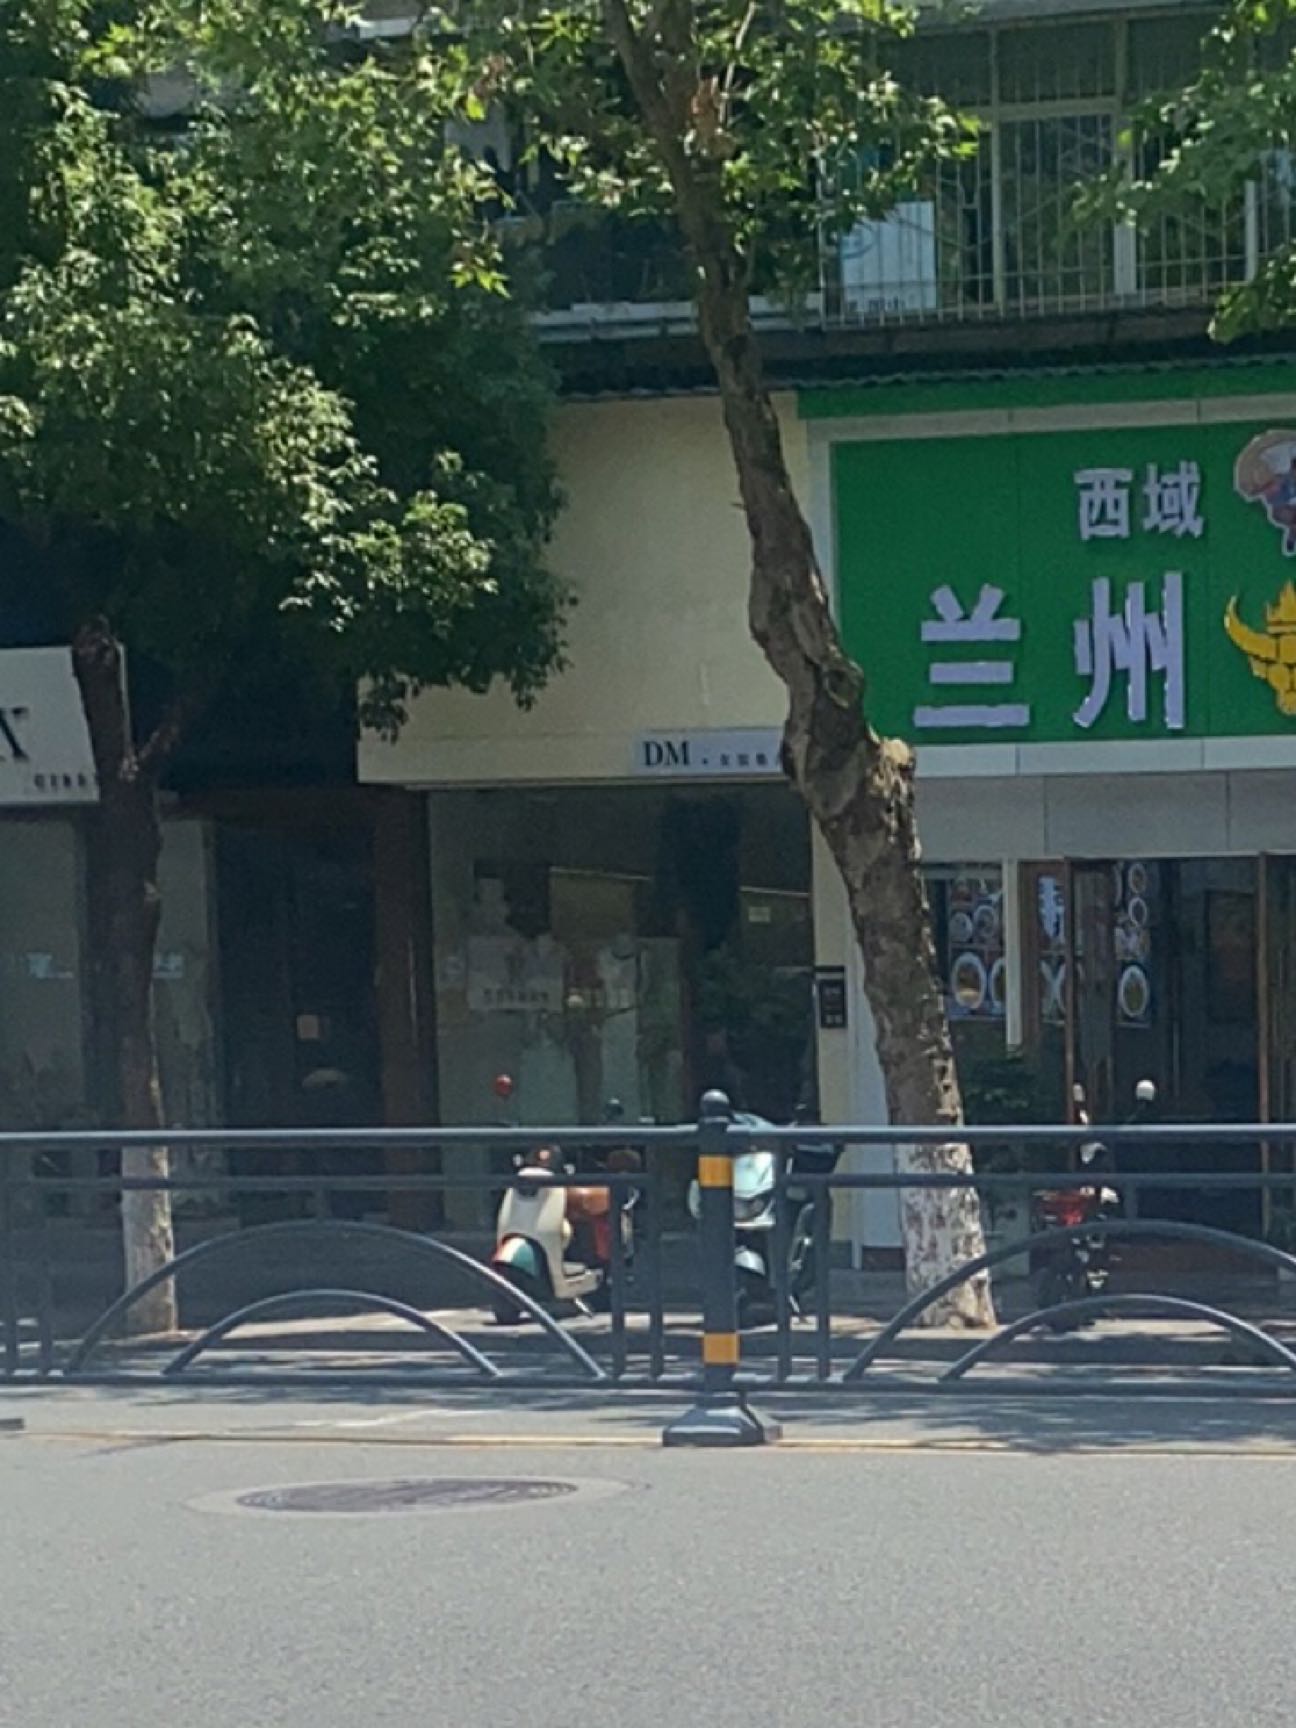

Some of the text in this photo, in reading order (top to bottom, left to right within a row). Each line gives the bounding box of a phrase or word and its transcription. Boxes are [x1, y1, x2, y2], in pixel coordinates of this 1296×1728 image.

[1074, 460, 1204, 541] 西域
[914, 571, 1185, 730] 兰州
[642, 739, 692, 767] DM
